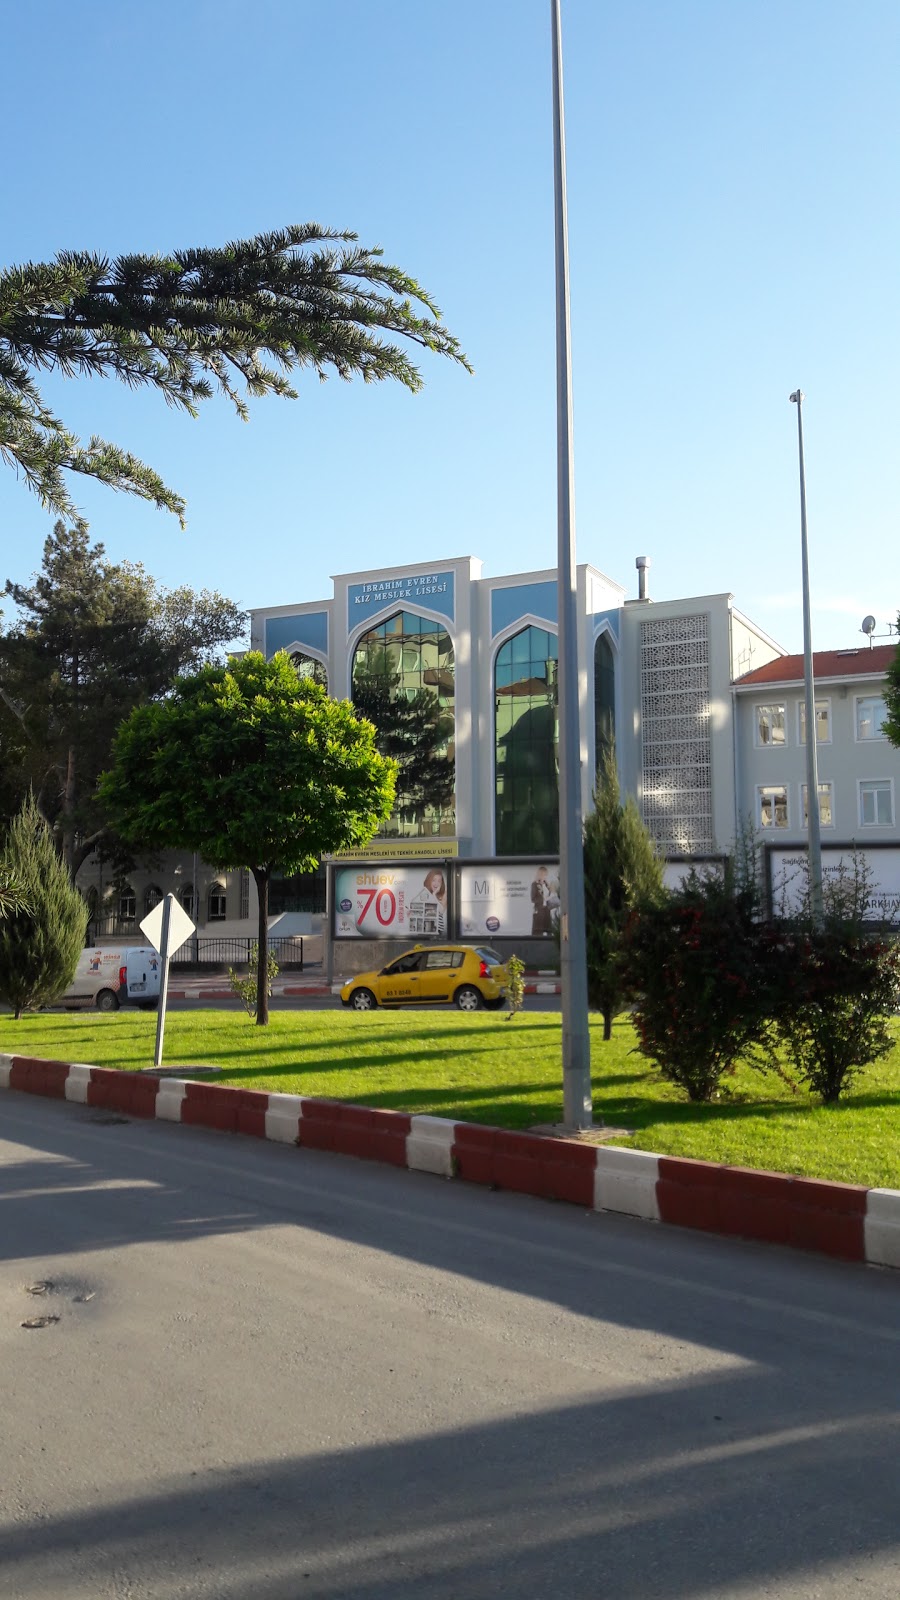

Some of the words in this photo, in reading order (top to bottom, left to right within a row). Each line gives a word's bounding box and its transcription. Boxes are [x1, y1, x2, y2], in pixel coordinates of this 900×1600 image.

[355, 595, 370, 604] KIZ
[374, 590, 411, 600] MESLEK
[416, 582, 446, 595] LİSESİ
[363, 580, 402, 592] İBRAHİM
[408, 576, 438, 586] EVREN
[357, 888, 396, 926] 70
